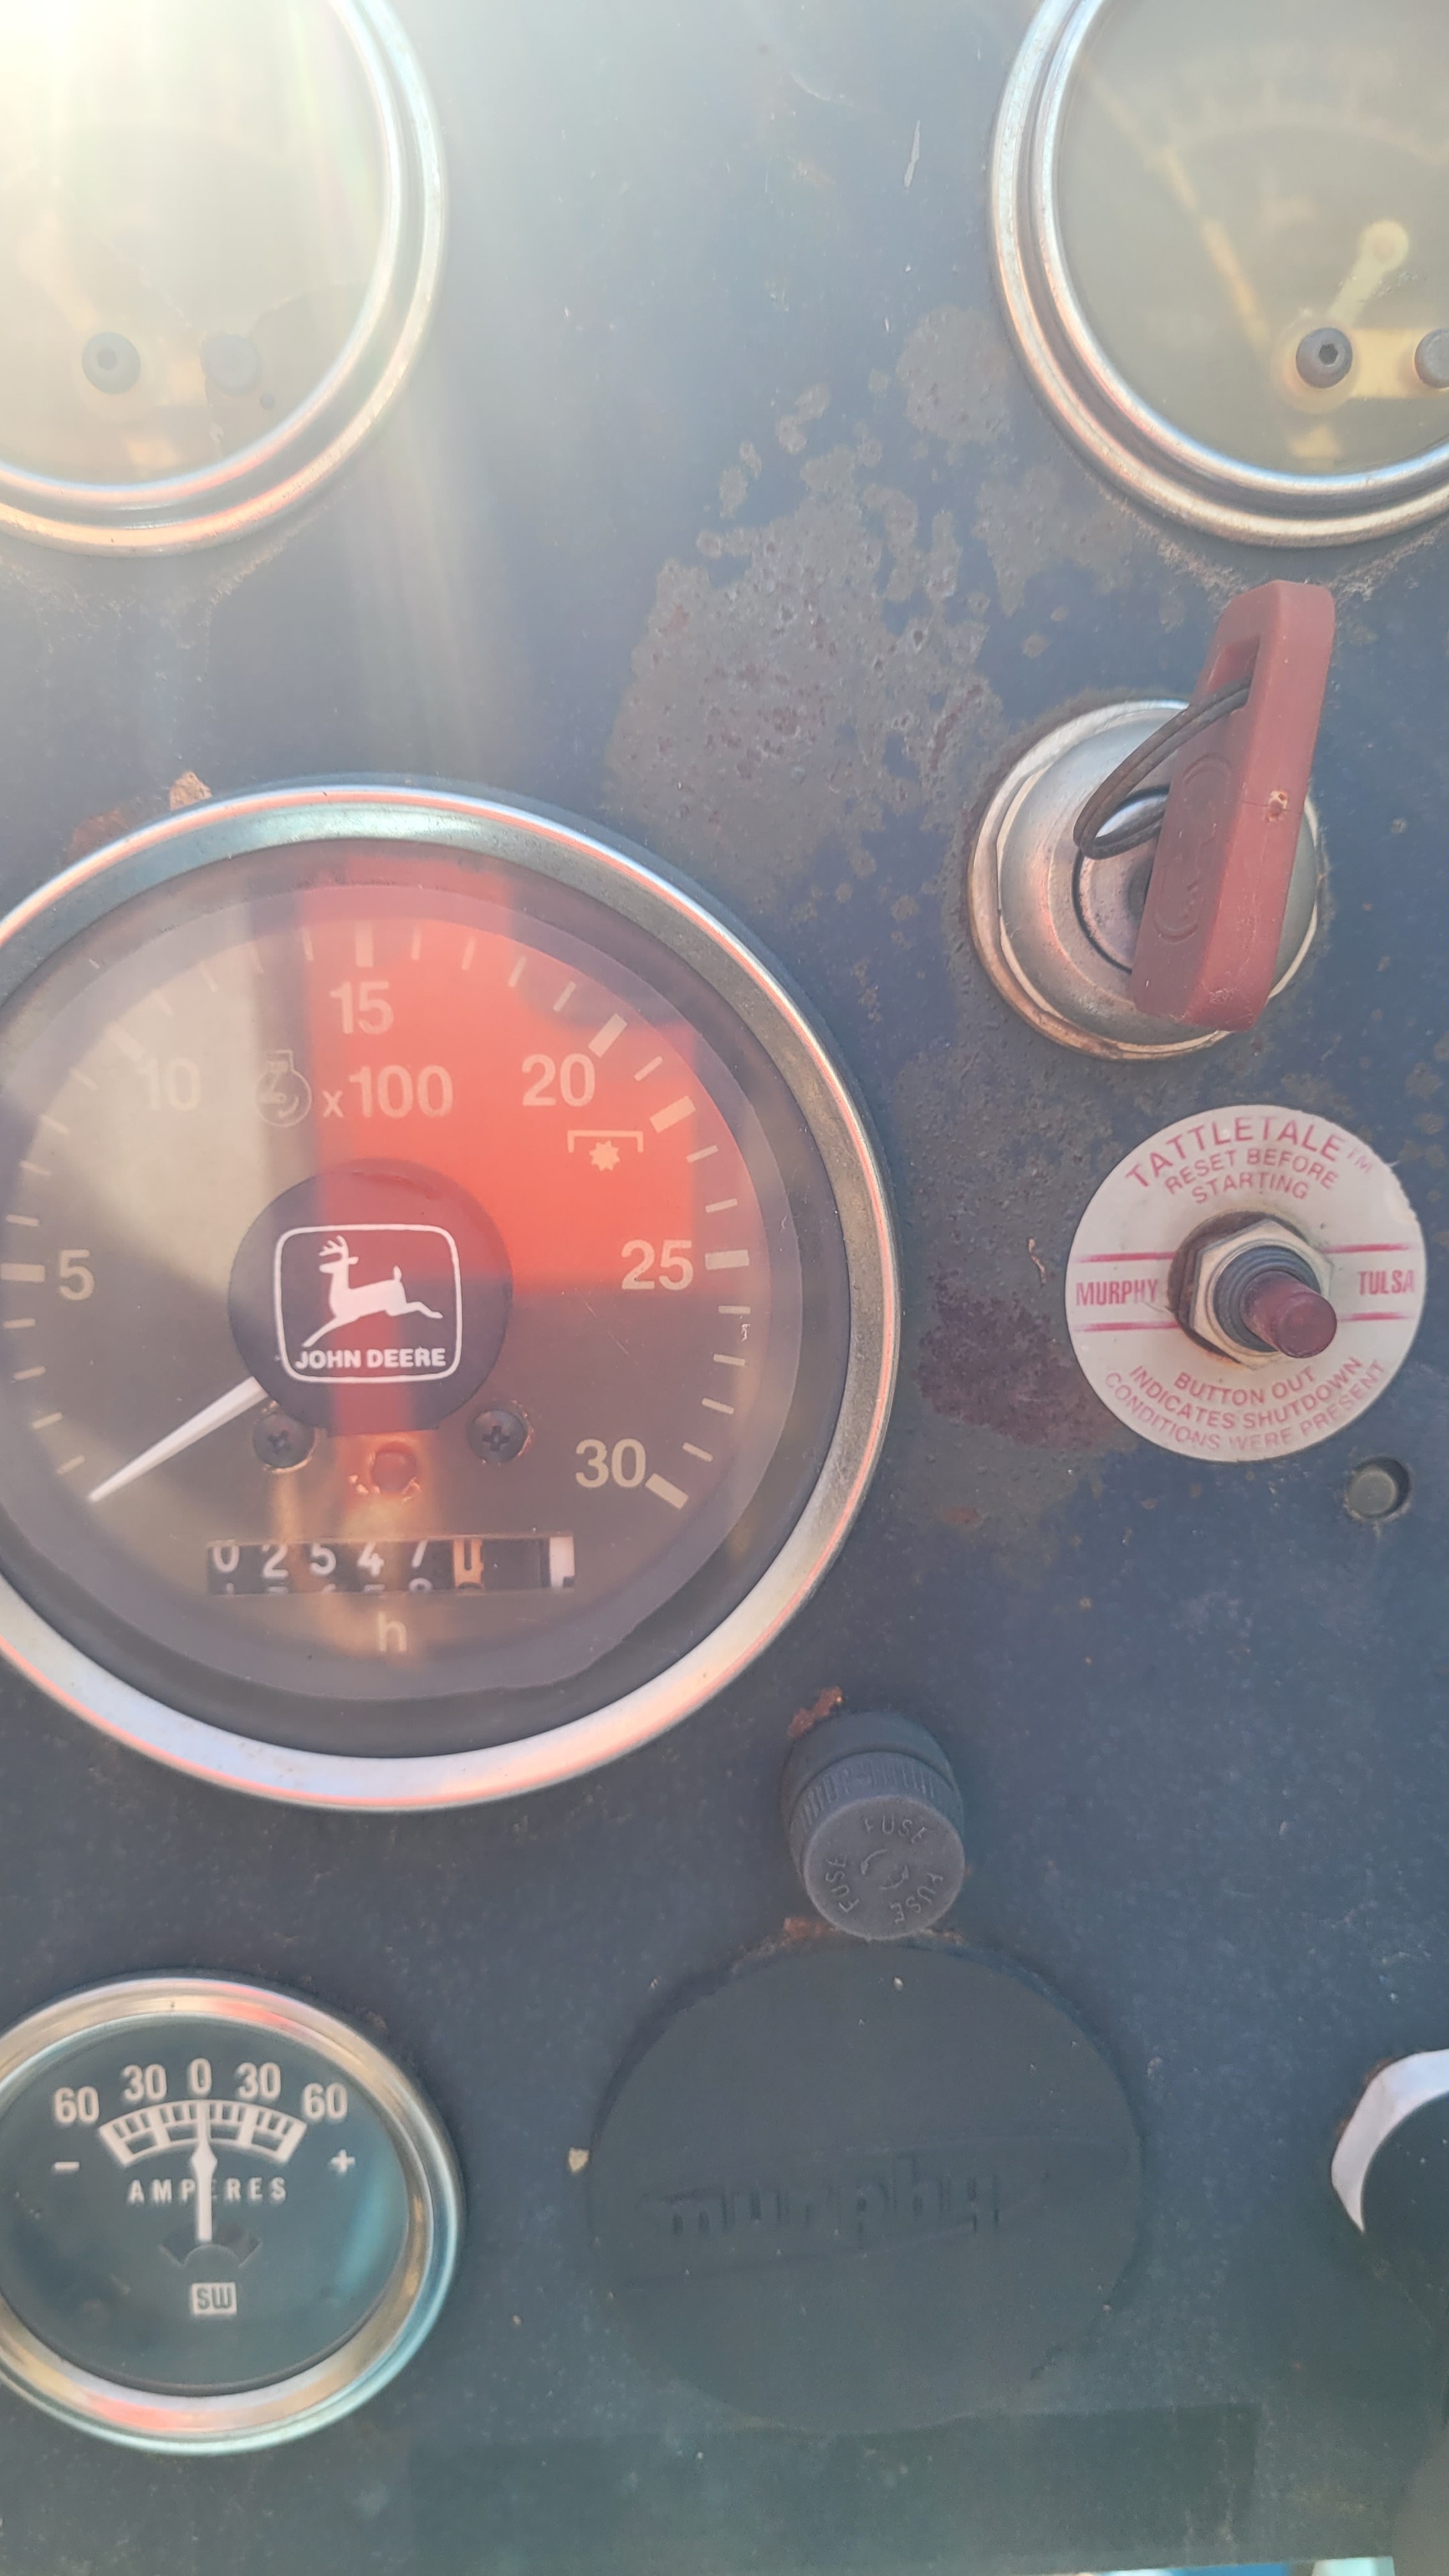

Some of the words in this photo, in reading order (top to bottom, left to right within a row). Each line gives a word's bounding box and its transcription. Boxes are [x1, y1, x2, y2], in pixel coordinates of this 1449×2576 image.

[331, 981, 394, 1034] 15
[137, 1057, 201, 1111] 10
[521, 1054, 596, 1107] 20
[1164, 1149, 1236, 1194] RESET
[1246, 1148, 1338, 1190] BEFORE
[1192, 1171, 1309, 1204] STARTING
[58, 1249, 95, 1301] 5
[621, 1239, 694, 1290] 25
[1357, 1269, 1415, 1296] TULSA
[1075, 1278, 1159, 1306] MURPHY
[295, 1349, 362, 1369] JOHN
[366, 1347, 446, 1368] DEERE
[1105, 1371, 1221, 1450] CONDITIONS
[1228, 1428, 1293, 1450] WERE
[1299, 1358, 1385, 1436] PRESENT
[1129, 1364, 1235, 1429] INDICATES
[1243, 1356, 1362, 1428] SHUTDOWN
[1173, 1371, 1267, 1406] BUTTON
[1271, 1365, 1318, 1400] OUT
[576, 1438, 646, 1488] 30
[378, 1611, 408, 1652] h
[863, 1815, 928, 1844] FUSE
[825, 1854, 860, 1913] FUSE
[890, 1872, 944, 1924] FUSE
[54, 2086, 100, 2124] 60
[122, 2063, 167, 2101] 30
[187, 2057, 213, 2096] 0
[235, 2061, 282, 2100] 30
[303, 2082, 348, 2121] 60
[127, 2177, 286, 2202] AMPRES
[197, 2284, 231, 2310] SW
